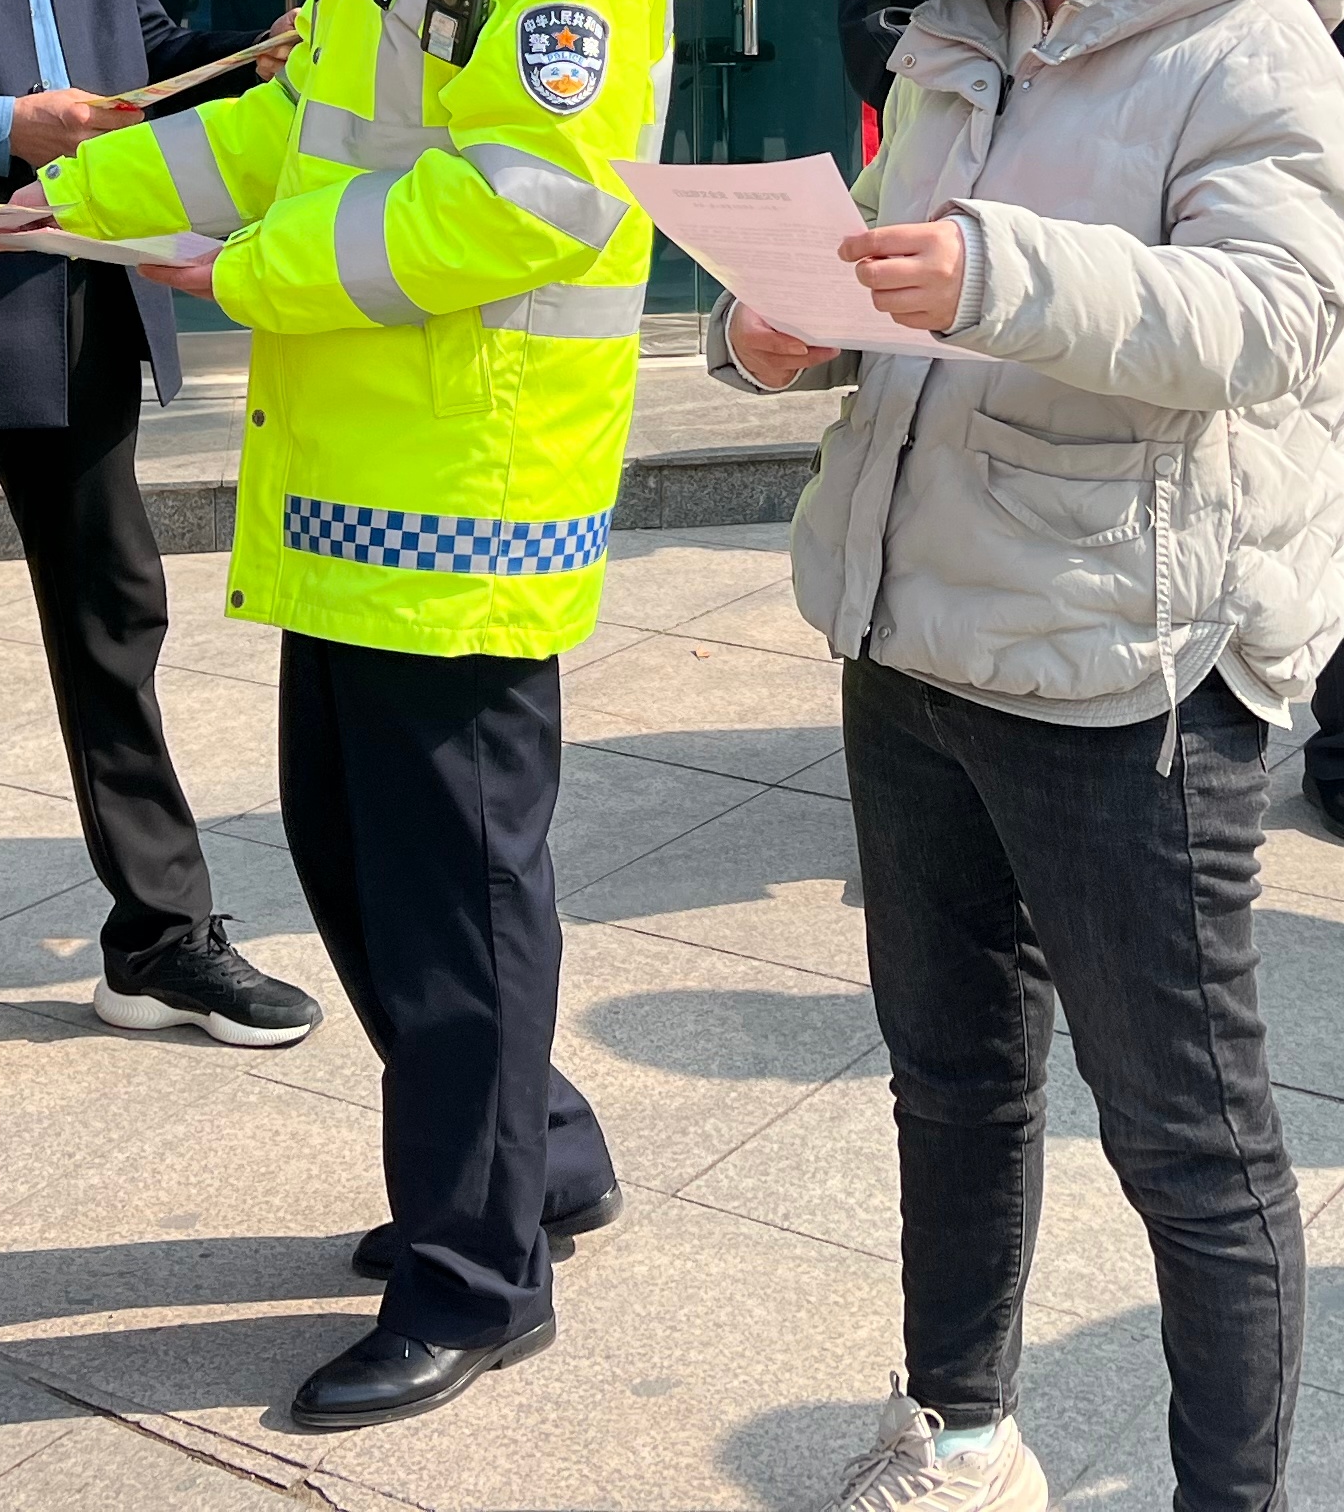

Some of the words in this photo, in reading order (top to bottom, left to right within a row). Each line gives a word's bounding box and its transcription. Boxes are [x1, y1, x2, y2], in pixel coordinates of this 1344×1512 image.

[524, 10, 604, 40] 中华人民共和国
[546, 51, 586, 65] POLICE
